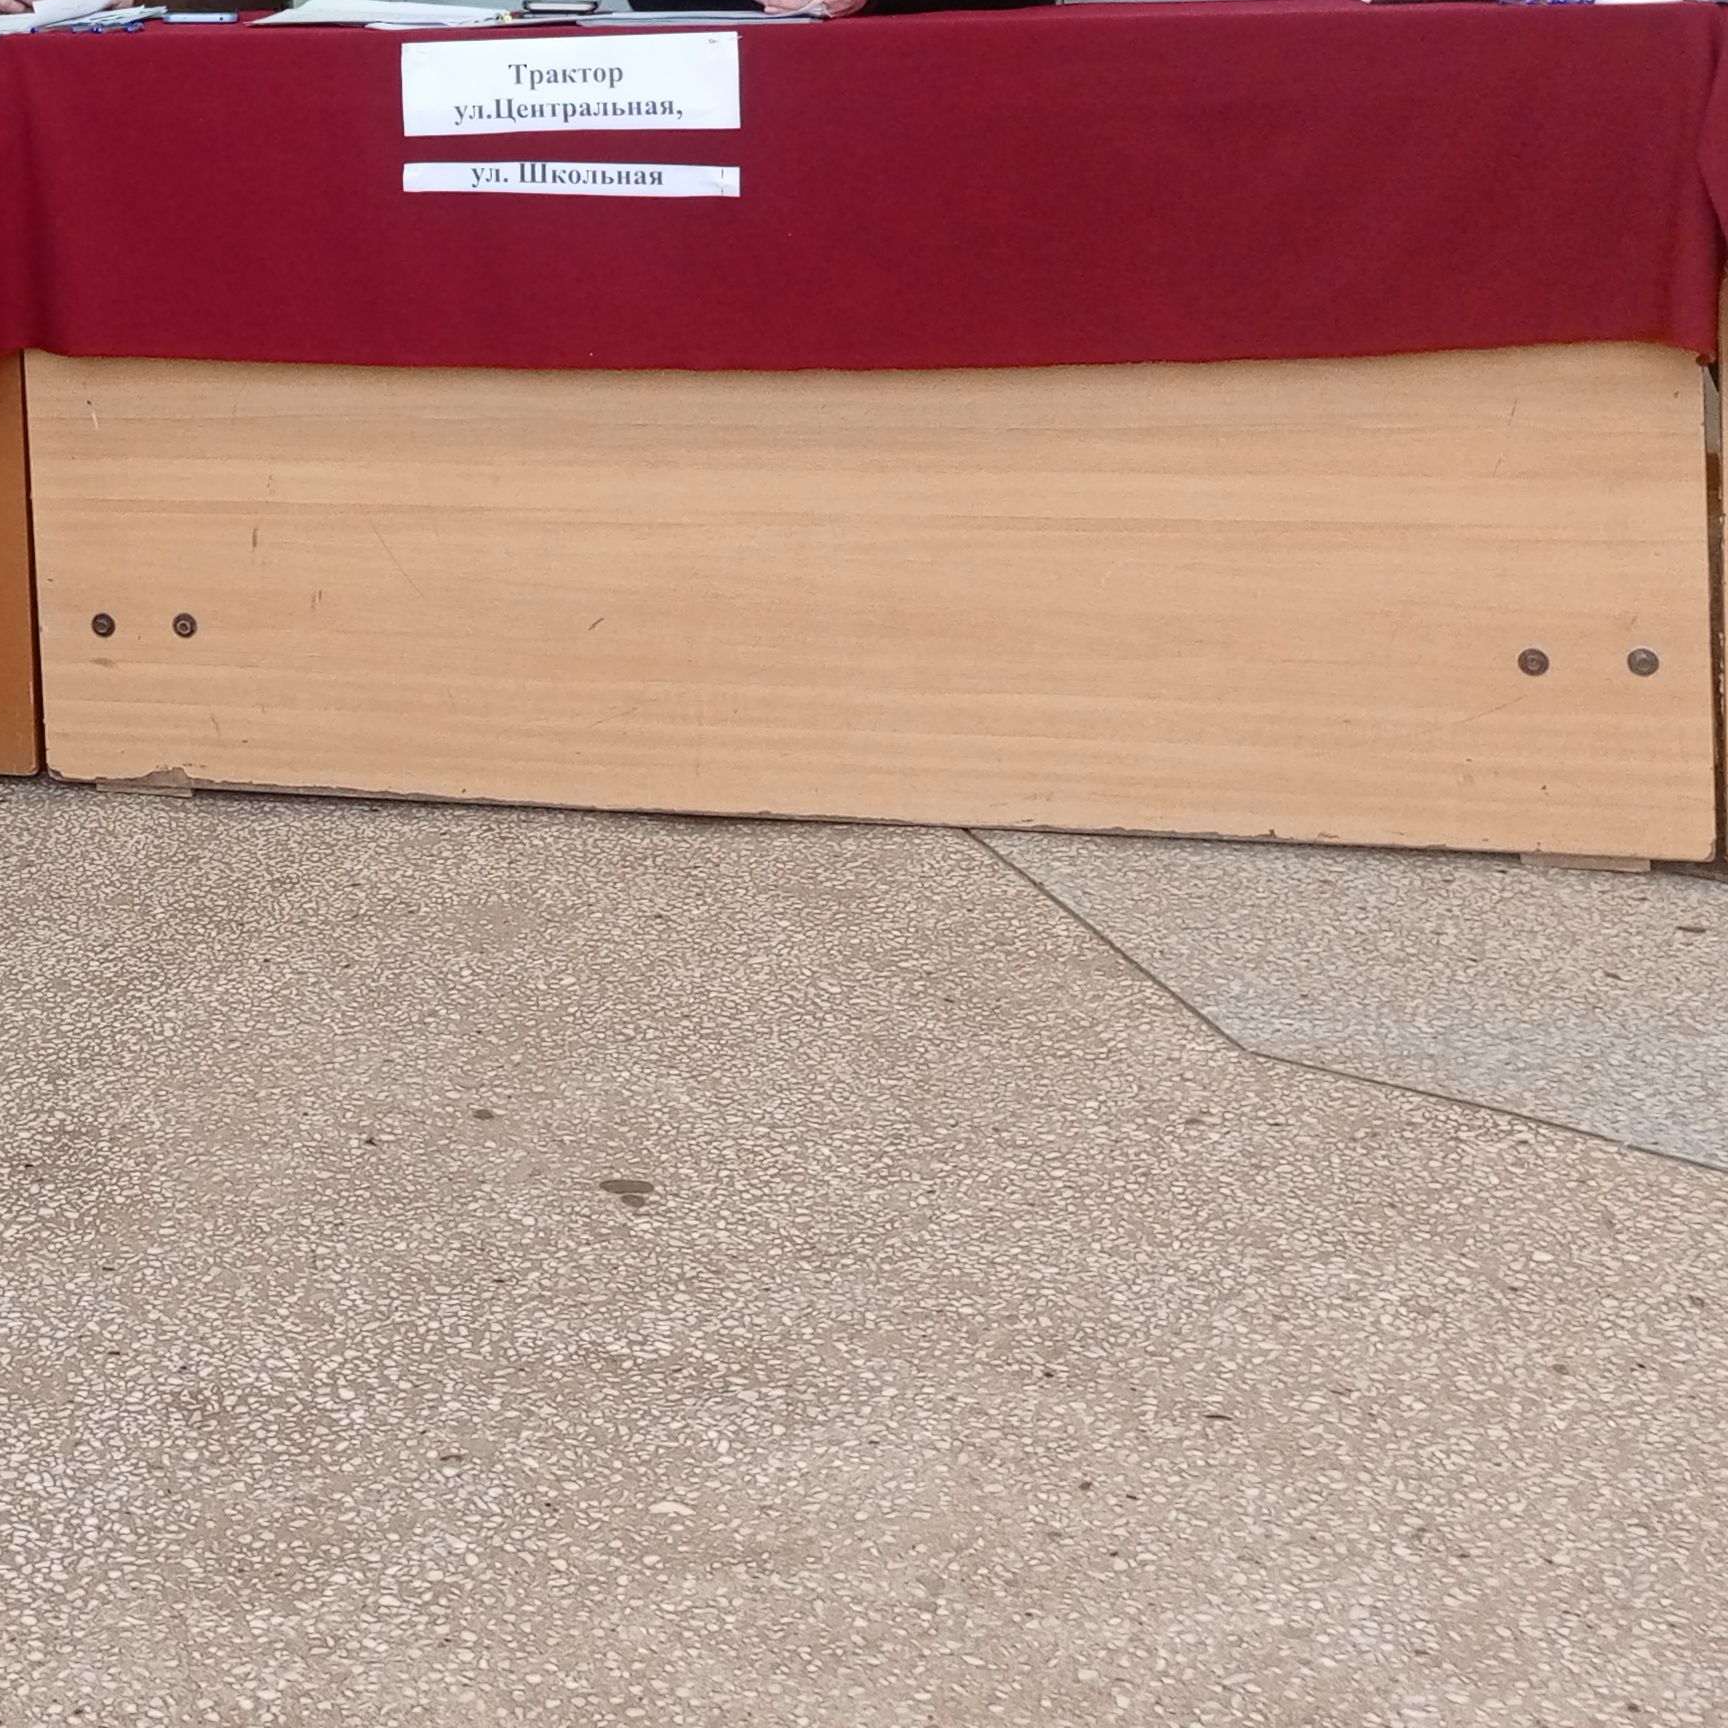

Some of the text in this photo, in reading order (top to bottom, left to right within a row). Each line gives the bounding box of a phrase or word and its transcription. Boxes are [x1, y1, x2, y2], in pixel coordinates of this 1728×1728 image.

[508, 63, 624, 91] Трактор
[453, 97, 684, 126] ул.Центральная,
[471, 162, 664, 188] ул. Школьная
